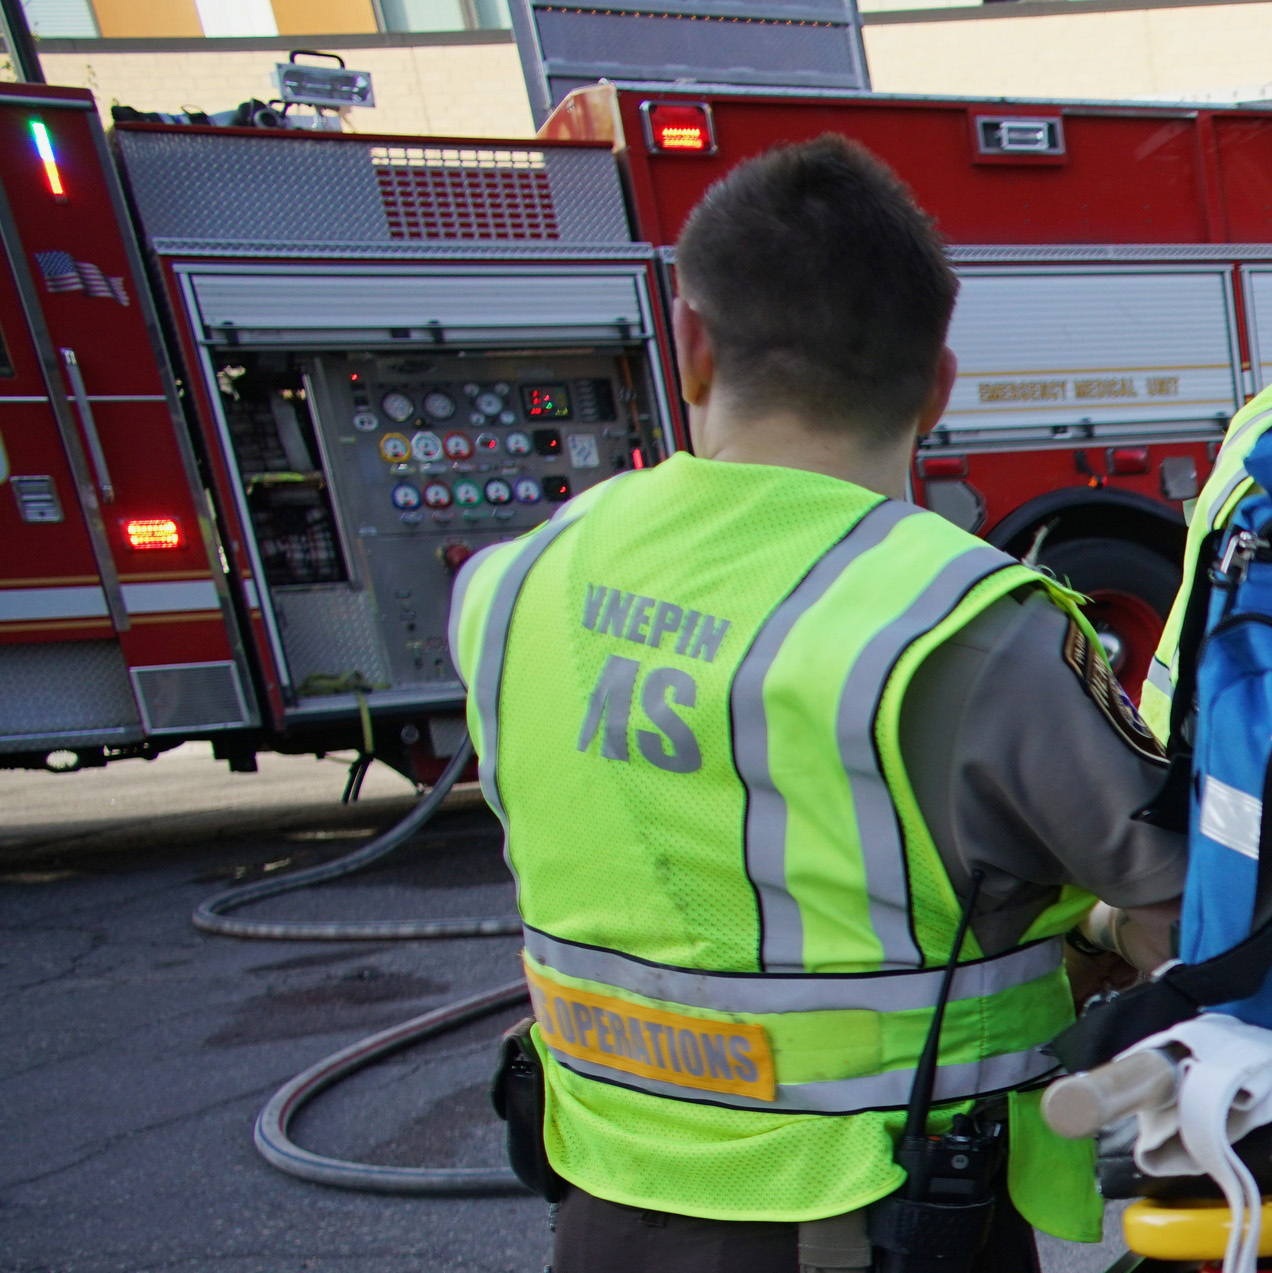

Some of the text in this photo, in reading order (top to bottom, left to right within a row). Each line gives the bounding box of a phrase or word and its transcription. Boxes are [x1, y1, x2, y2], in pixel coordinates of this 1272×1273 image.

[978, 376, 1180, 403] EMERGENCY MEDICAL UNIT
[554, 997, 759, 1084] OPERATIONS
